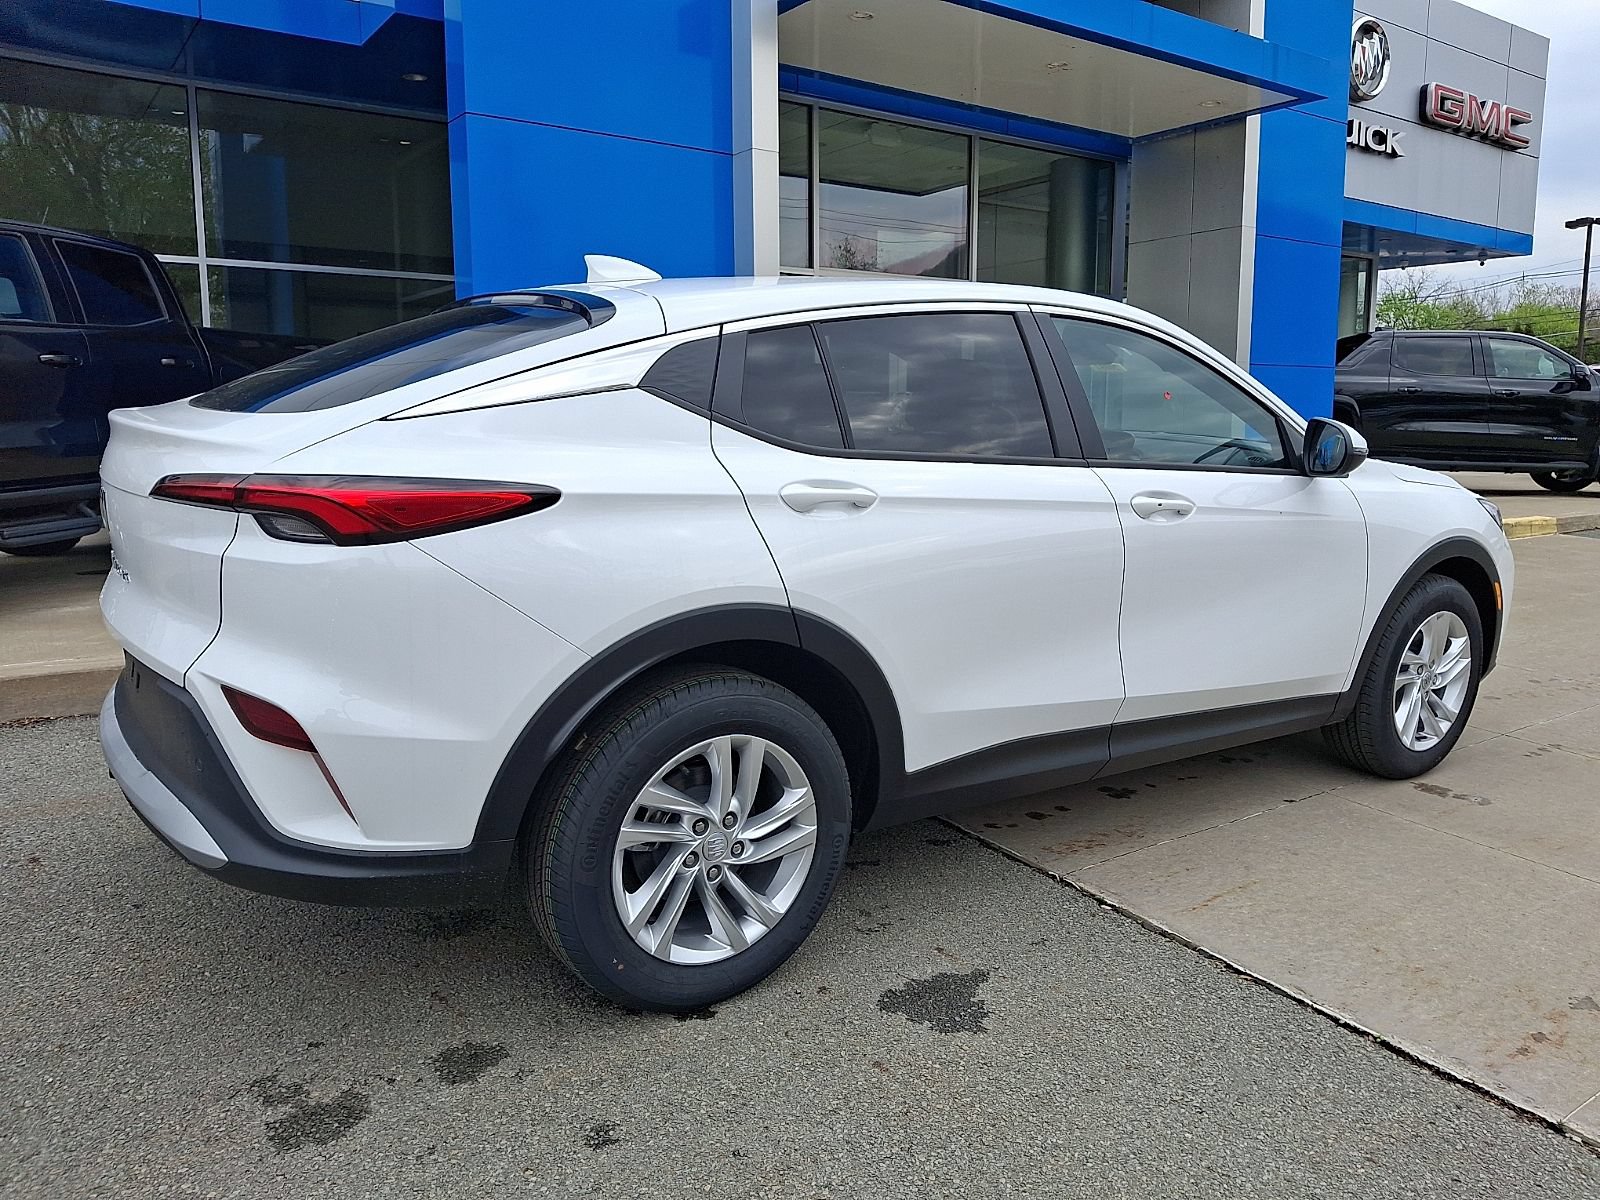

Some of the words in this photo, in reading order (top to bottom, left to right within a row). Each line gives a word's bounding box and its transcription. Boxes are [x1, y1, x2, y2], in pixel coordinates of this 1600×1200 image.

[1346, 118, 1407, 157] UICK
[1423, 82, 1533, 149] GMC
[581, 771, 630, 873] Continental
[806, 834, 844, 918] Continental
